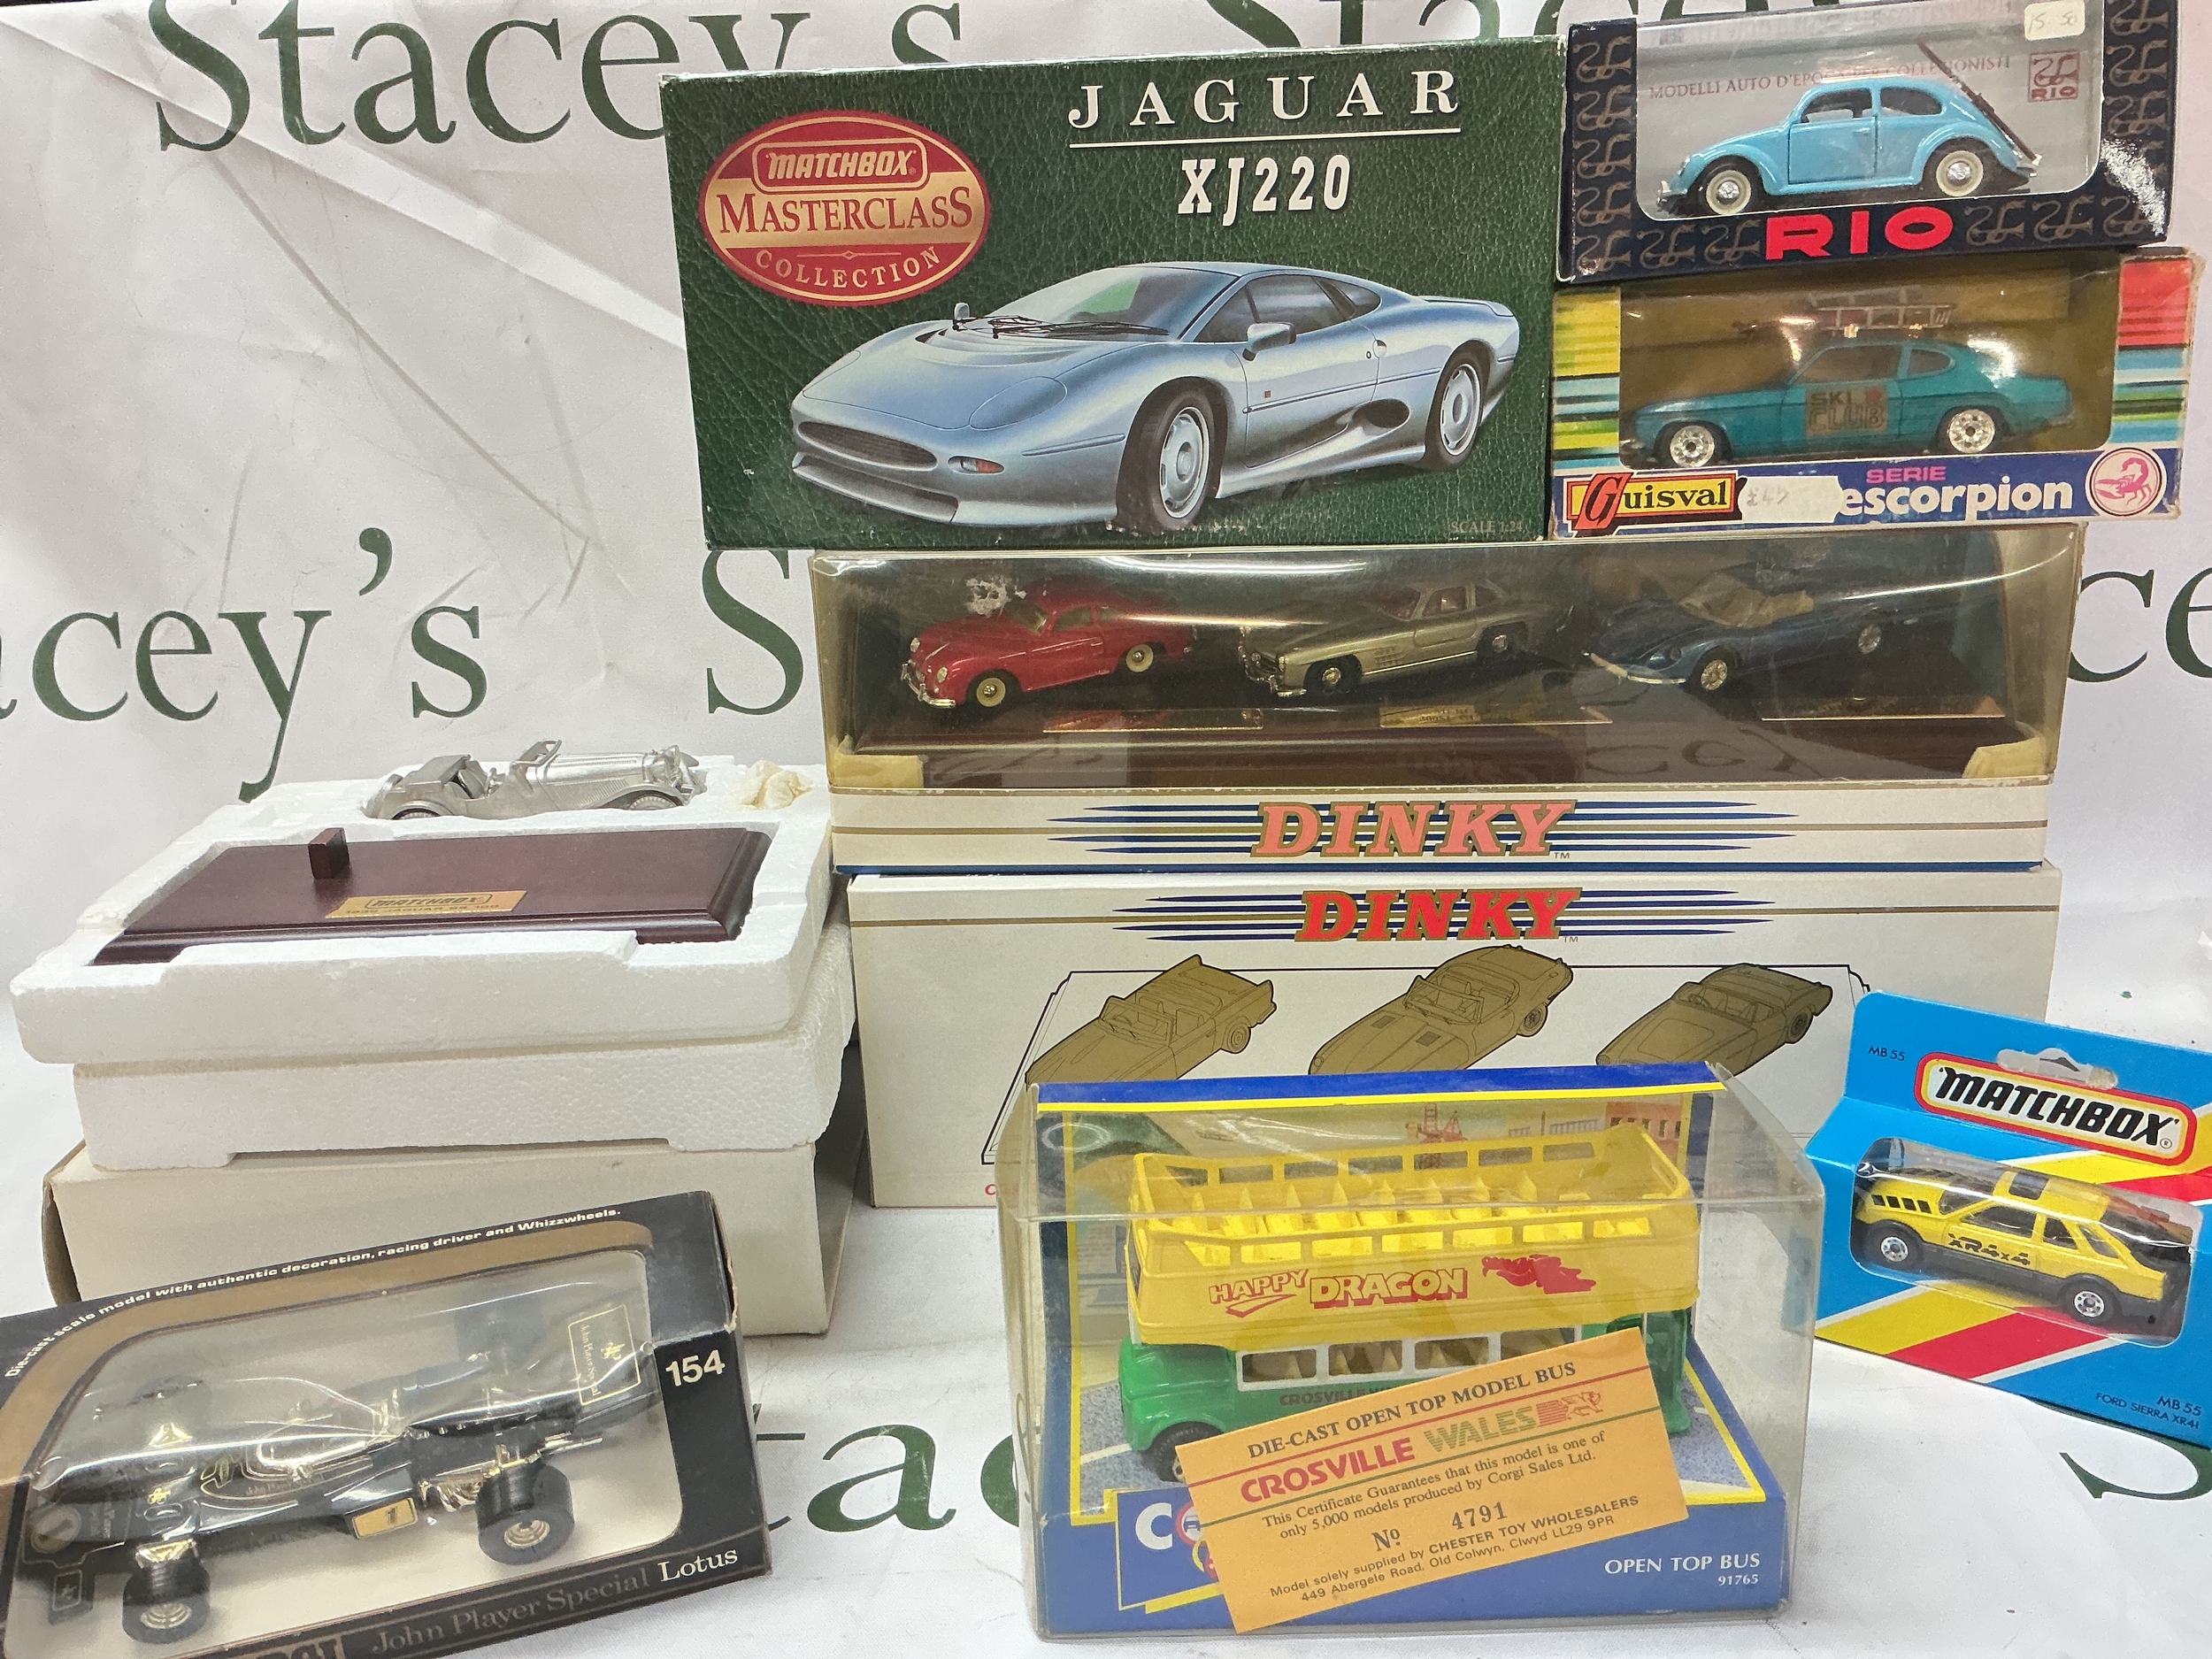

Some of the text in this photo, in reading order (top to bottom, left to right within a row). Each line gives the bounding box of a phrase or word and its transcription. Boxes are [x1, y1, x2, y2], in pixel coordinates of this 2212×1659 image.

[1068, 70, 1458, 128] JAGUAR
[1648, 81, 1724, 100] MODELLI
[1728, 75, 1771, 93] AUTO
[1886, 56, 2011, 77] COLLEONISTI
[2031, 87, 2077, 101] RIO
[766, 150, 915, 180] MATCHBOX
[1178, 154, 1351, 227] XJ220
[1765, 205, 1954, 261] RIO
[756, 246, 941, 289] COLLECTION
[1810, 389, 1852, 406] SKI
[1866, 466, 1947, 484] SERIE
[1584, 474, 1727, 529] Guisval
[1839, 477, 2072, 524] escorpion
[1451, 520, 1523, 533] SCALE 1:24
[0, 528, 487, 802] cey's
[1250, 800, 1578, 857] DINKY
[372, 896, 478, 907] MATCHBOX
[1294, 887, 1583, 942] DINKY
[1868, 1045, 1906, 1062] MB 55
[1936, 1066, 2176, 1146] MATCHBOX
[53, 1312, 96, 1338] scale
[98, 1292, 151, 1315] model
[155, 1283, 193, 1297] with
[196, 1268, 278, 1288] authentic
[281, 1250, 376, 1273] decoration,
[378, 1240, 429, 1258] racing
[433, 1231, 482, 1248] driver
[485, 1224, 514, 1237] and
[517, 1209, 621, 1231] Whizzwheels.
[1209, 1268, 1468, 1309] HAPPY DRAGON
[665, 1349, 726, 1387] 154
[1247, 1362, 1577, 1458] DIE-CAST OPEN TOP MODEL BUS
[2096, 1392, 2127, 1408] FORD
[2131, 1402, 2169, 1421] SIERRA
[2157, 1396, 2202, 1417] MB 55
[1240, 1406, 1538, 1503] CROSVILLE WALES
[1262, 1430, 1606, 1527] This Certificate Guarantees that this model is one of
[1279, 1449, 1596, 1540] only 5,000 models produced by Corgi Sales Ltd.
[1451, 1502, 1508, 1530] 4791
[1270, 1495, 1640, 1598] Model solely supplied by CHESTER TOY WHOLESALERS
[1302, 1515, 1615, 1602] 449 Abergele Road, Old Colwyn, Clwyd LL29 9PR
[1604, 1553, 1760, 1574] OPEN TOP BUS
[373, 1626, 445, 1656] John
[449, 1601, 541, 1637] Player
[546, 1566, 649, 1613] Special
[658, 1548, 739, 1583] Lotus
[1717, 1574, 1759, 1586] 91765
